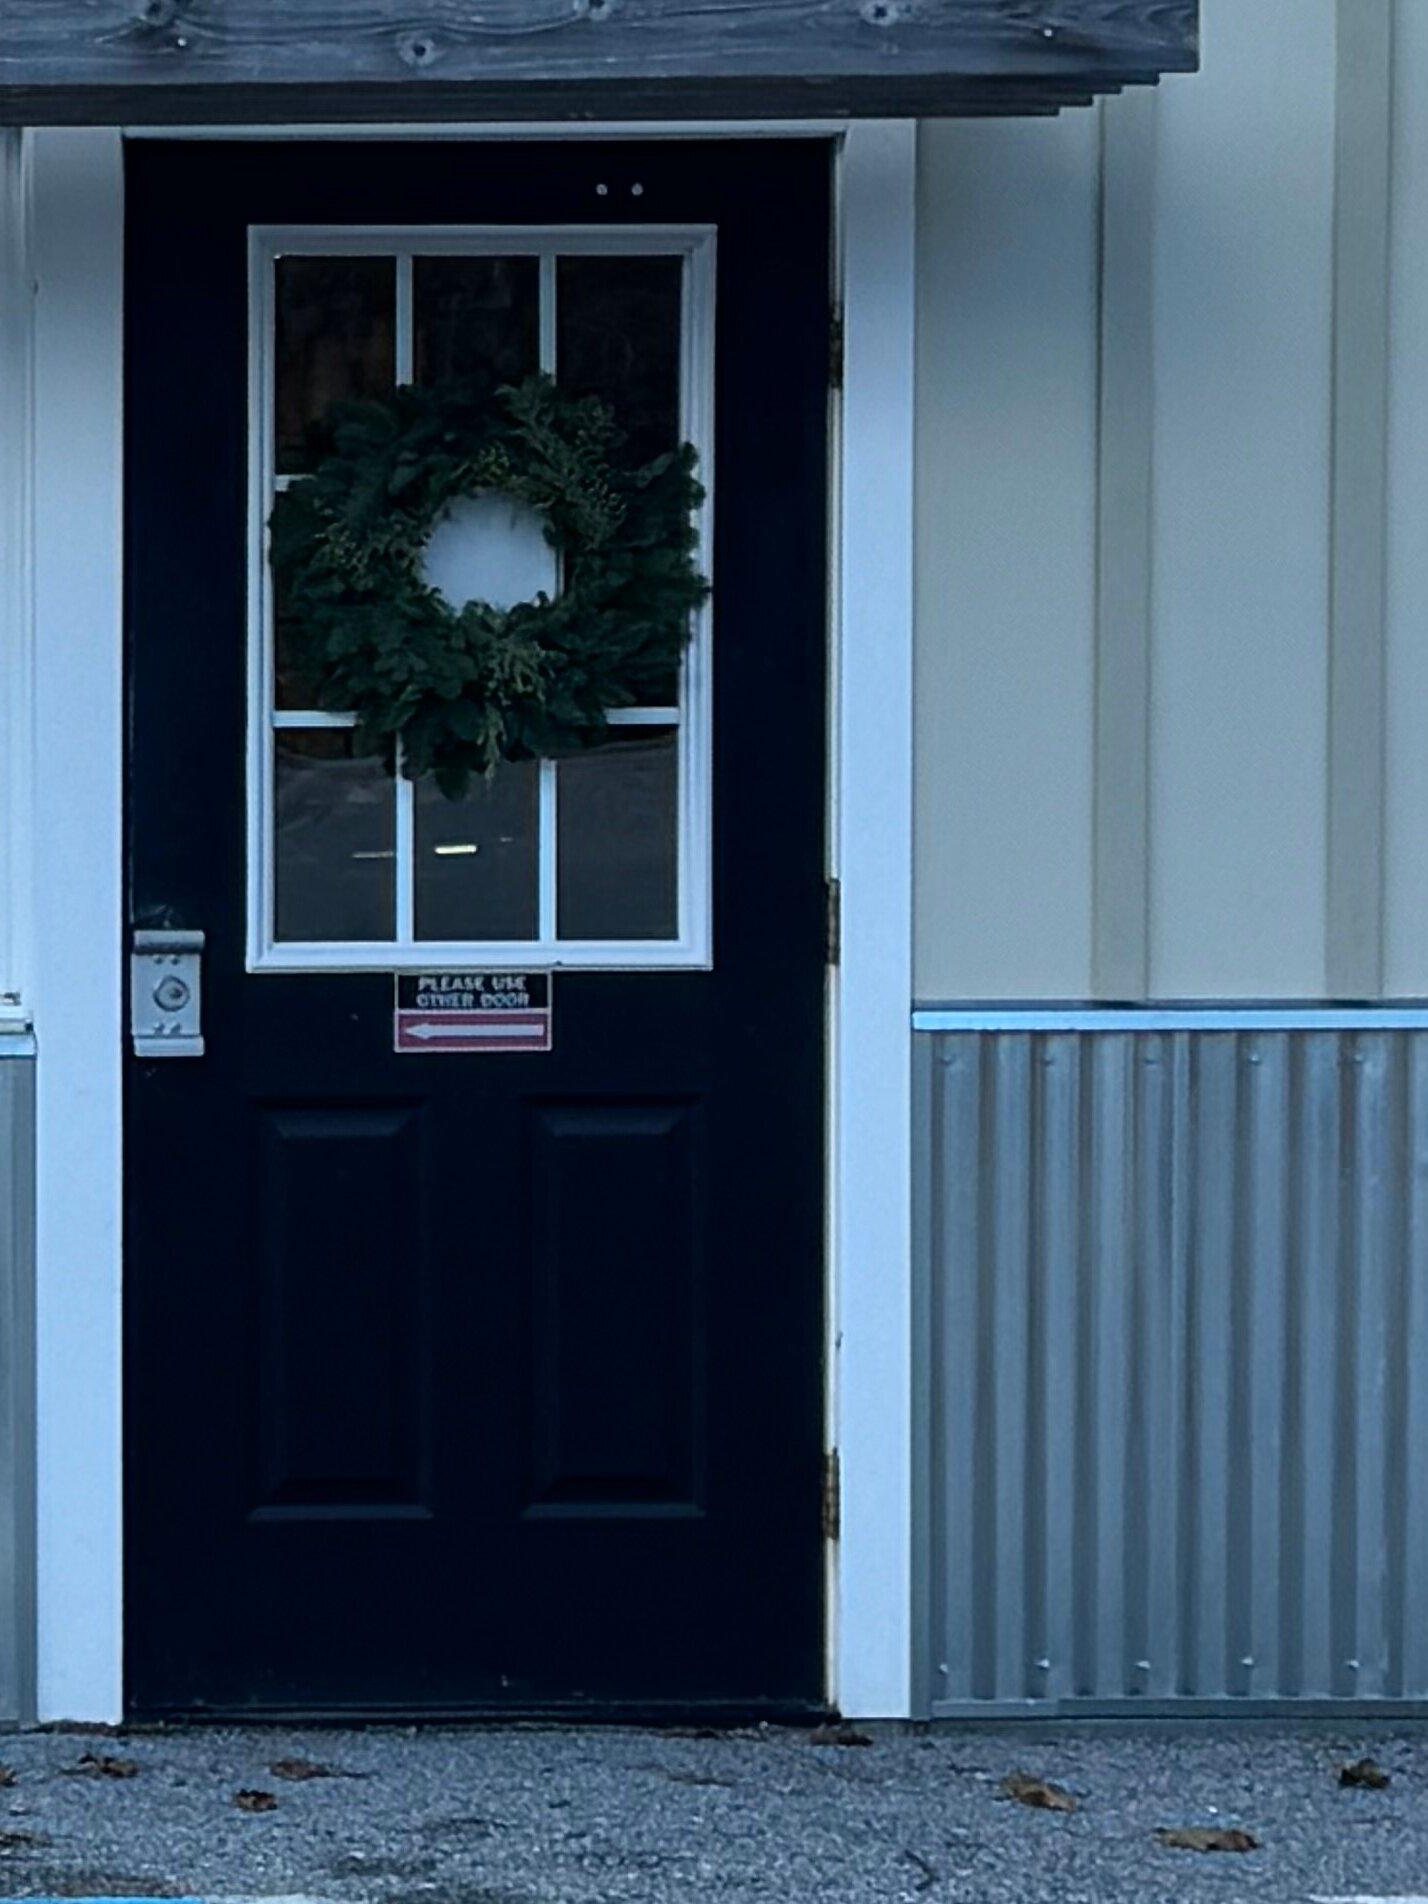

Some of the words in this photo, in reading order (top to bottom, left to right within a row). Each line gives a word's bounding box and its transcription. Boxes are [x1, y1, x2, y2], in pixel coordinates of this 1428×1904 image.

[418, 976, 485, 991] PLEASE
[492, 976, 526, 990] USE
[416, 993, 474, 1007] OTHER
[480, 993, 529, 1007] DOOR
